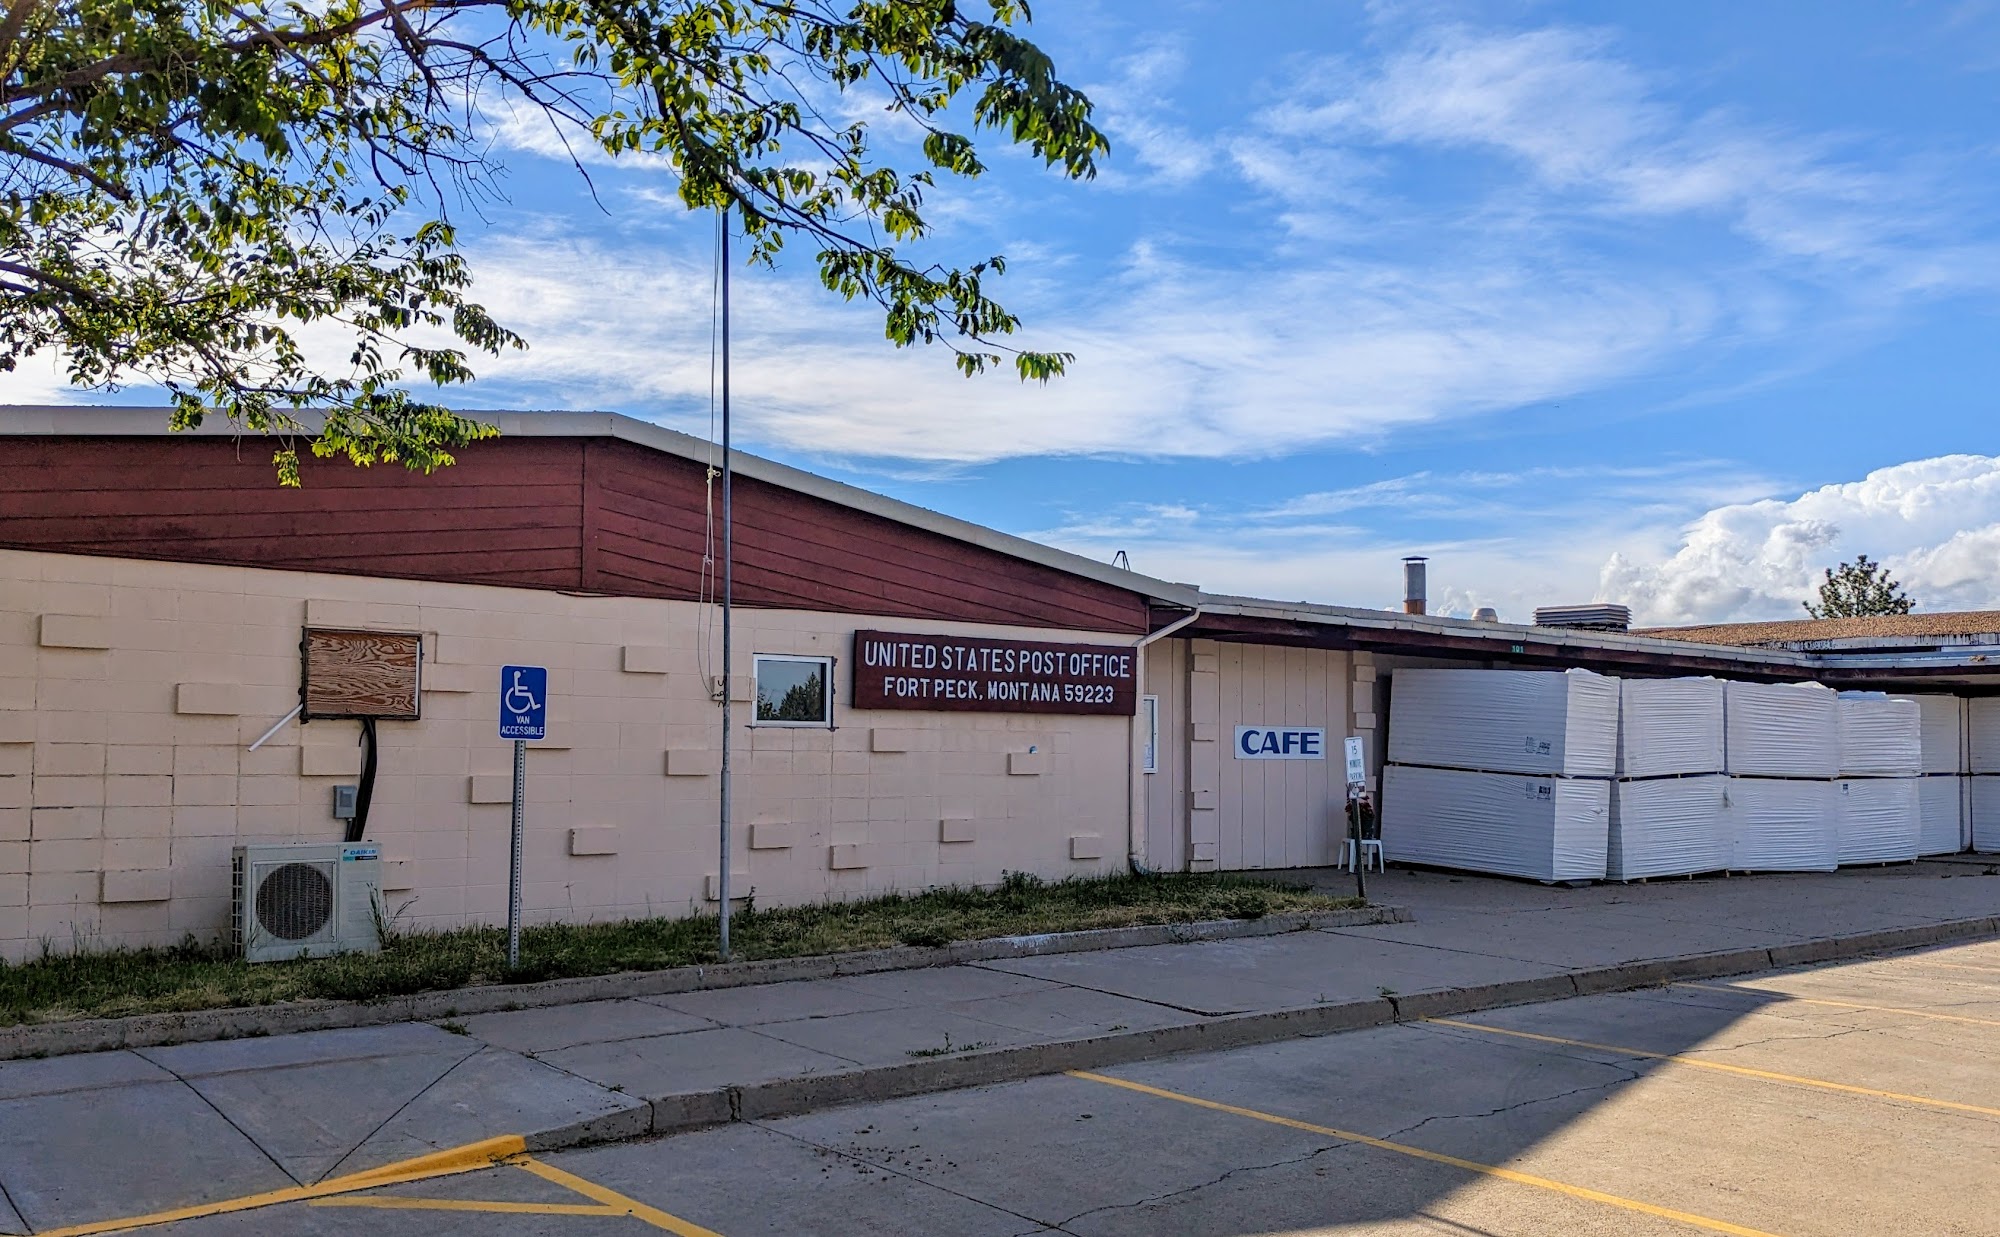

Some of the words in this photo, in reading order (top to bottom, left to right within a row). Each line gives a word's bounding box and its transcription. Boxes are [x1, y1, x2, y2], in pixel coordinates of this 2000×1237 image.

[865, 641, 937, 669] UNITED
[941, 645, 1015, 673] STATES
[1019, 650, 1066, 675] POST
[1069, 653, 1130, 678] OFFICE
[884, 676, 930, 698] FORT
[934, 679, 983, 701] PECK,
[987, 680, 1060, 702] MONTANA
[1064, 684, 1114, 703] 59223
[516, 715, 530, 724] VAN
[501, 725, 543, 735] ACCESSIBLE
[1241, 730, 1319, 755] CAFE
[1351, 745, 1357, 755] 15
